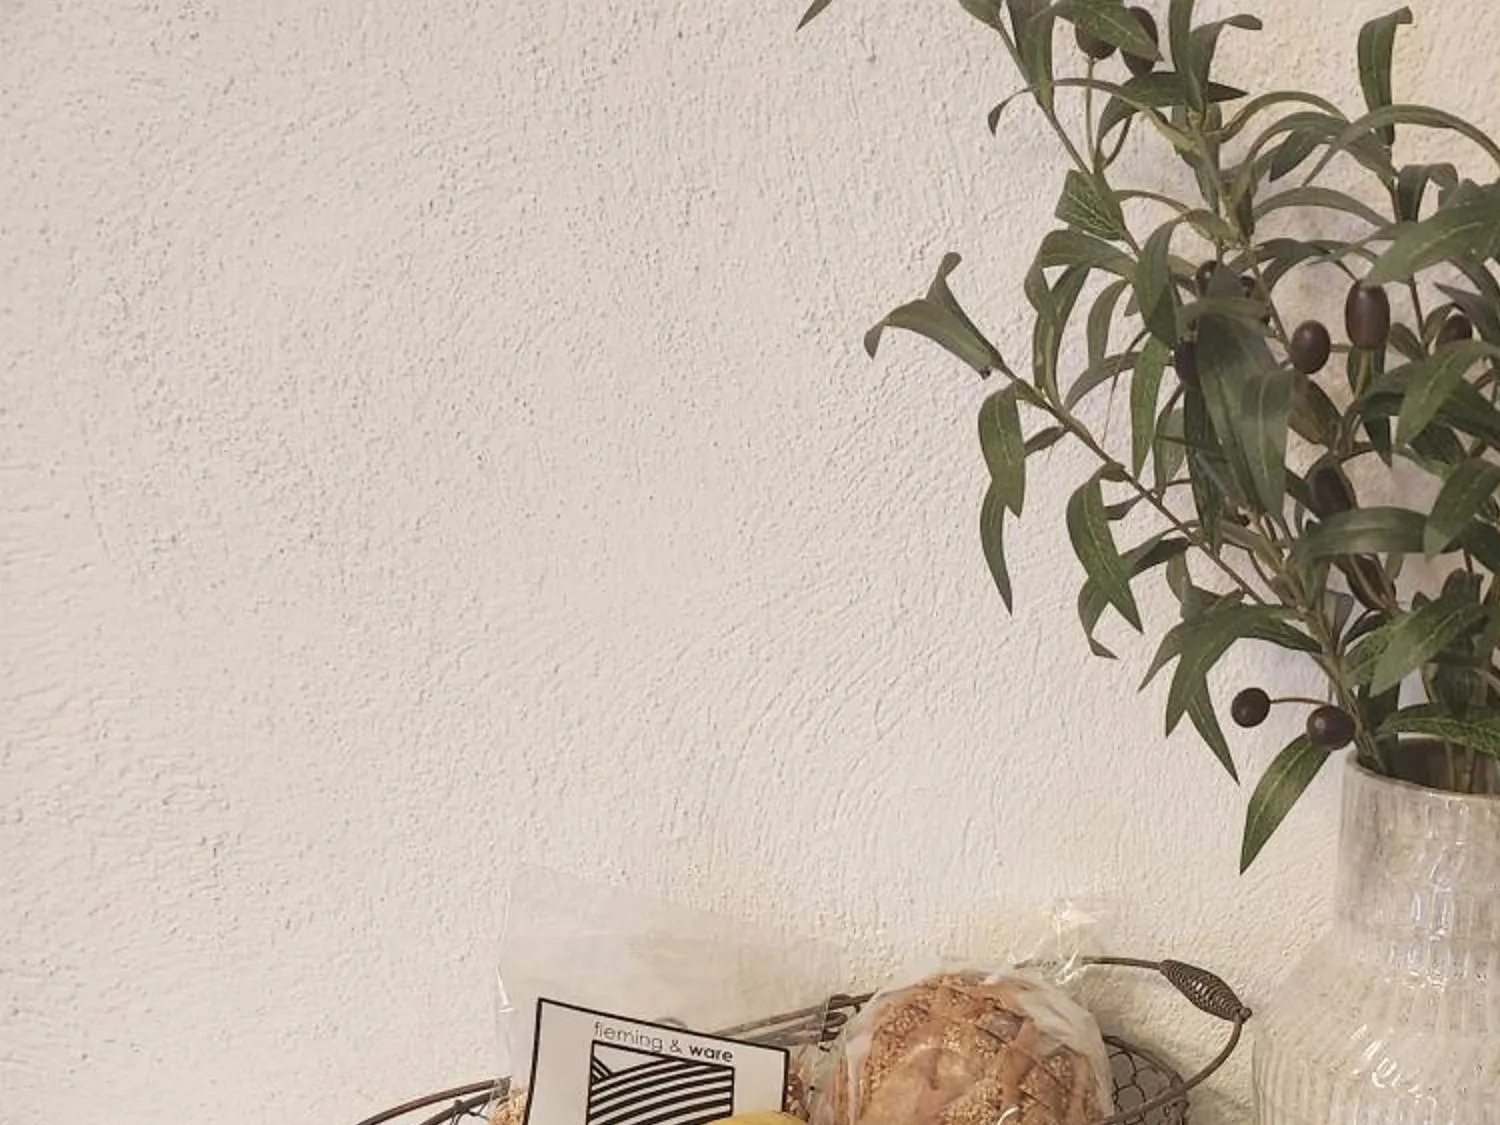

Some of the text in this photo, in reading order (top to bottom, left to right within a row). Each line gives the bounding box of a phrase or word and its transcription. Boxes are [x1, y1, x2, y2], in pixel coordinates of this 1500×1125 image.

[593, 1020, 734, 1064] fleming & ware
